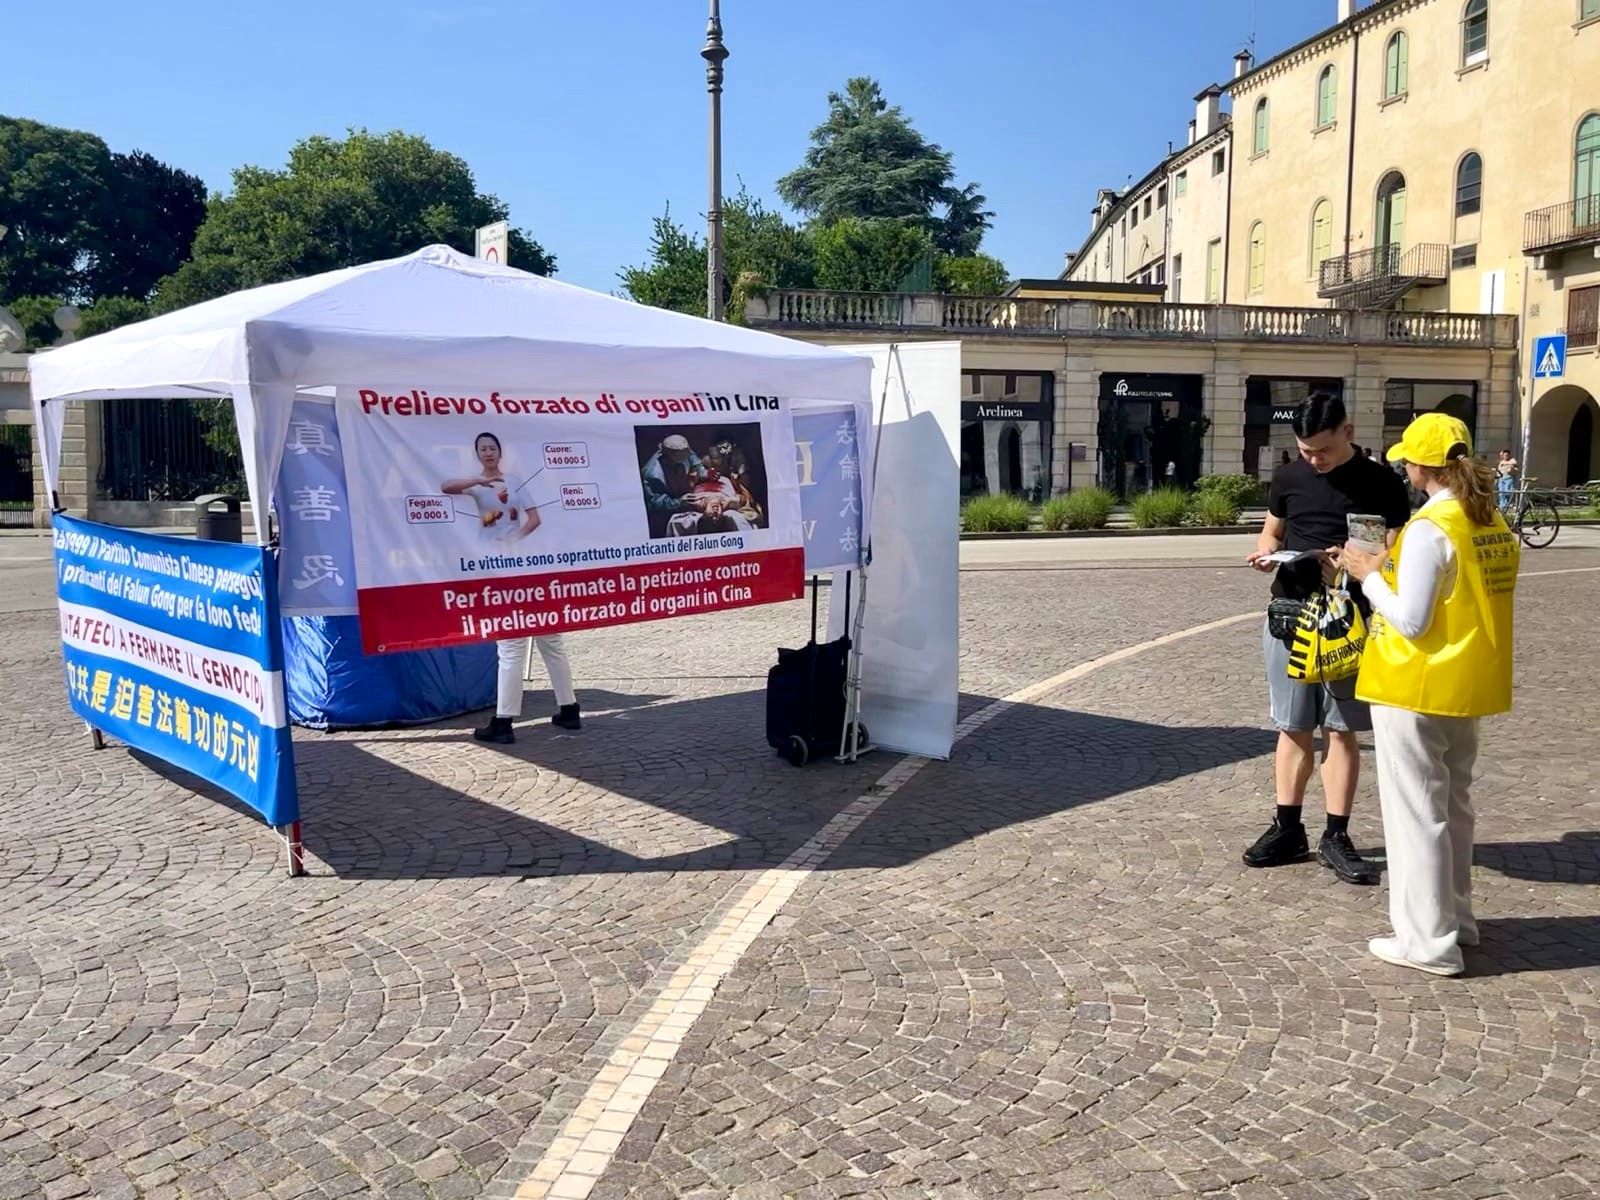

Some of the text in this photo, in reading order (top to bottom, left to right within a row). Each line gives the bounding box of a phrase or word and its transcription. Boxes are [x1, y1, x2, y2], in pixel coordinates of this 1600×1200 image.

[358, 389, 780, 419] Prelievo forzato di organi in Cina
[1272, 410, 1299, 420] MAX
[544, 445, 572, 454] Cuore:
[547, 457, 563, 465] 140
[564, 456, 580, 464] 000
[562, 487, 583, 496] Reni:
[408, 498, 443, 509] Fegato:
[576, 498, 592, 506] 000
[410, 511, 422, 520] 90
[423, 510, 442, 520] 000
[88, 535, 100, 558] il
[98, 538, 131, 566] Partito
[131, 544, 180, 578] Comunista
[181, 555, 215, 588] Cinese
[460, 535, 744, 572] Le vittime sono soprattutto praticanti del Falun Gong
[443, 561, 760, 610] Per favore firmate la petizione contro
[107, 572, 124, 598] del
[123, 576, 150, 605] Falun
[151, 583, 176, 618] Gong
[177, 596, 194, 620] per
[196, 594, 206, 622] la
[207, 598, 232, 630] loro
[461, 584, 752, 638] il prelievo forzato di organi in Cina
[119, 627, 129, 652] A
[128, 631, 183, 675] FERMARE
[185, 650, 200, 680] IL
